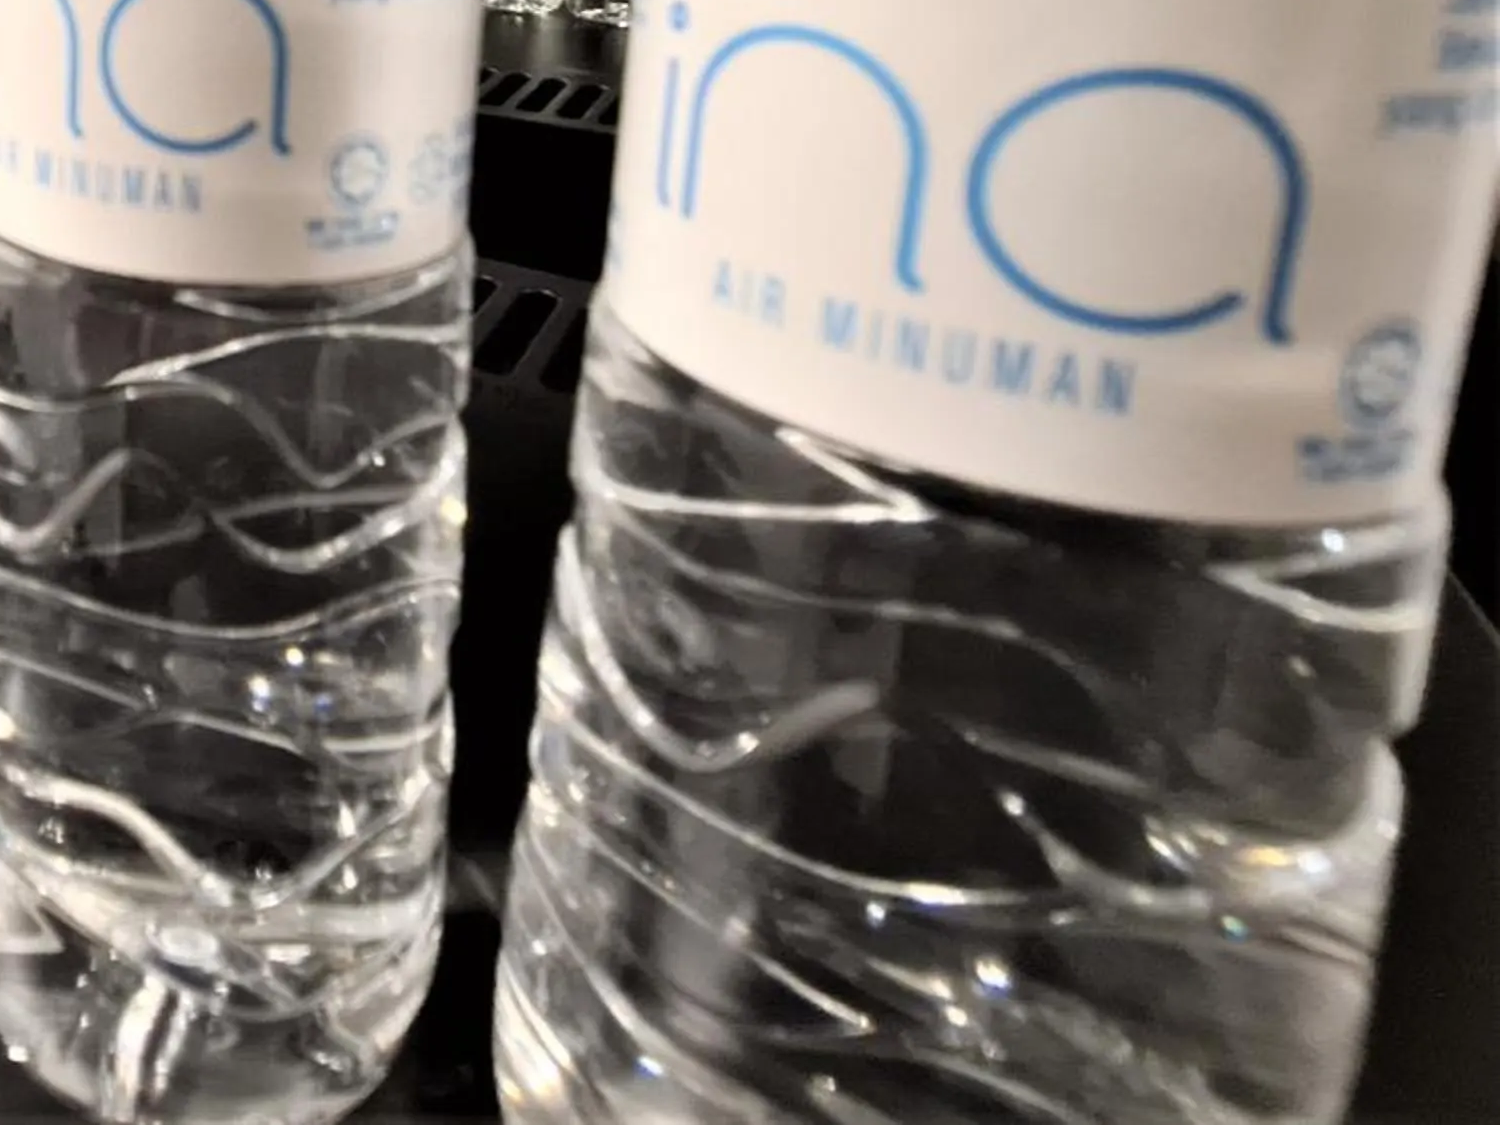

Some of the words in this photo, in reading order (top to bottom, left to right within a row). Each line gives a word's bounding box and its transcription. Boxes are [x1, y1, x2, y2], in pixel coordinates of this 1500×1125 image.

[33, 146, 203, 214] MINUMAN
[655, 0, 1310, 347] ina
[713, 259, 786, 328] AIR
[820, 296, 1139, 416] MINUMAN
